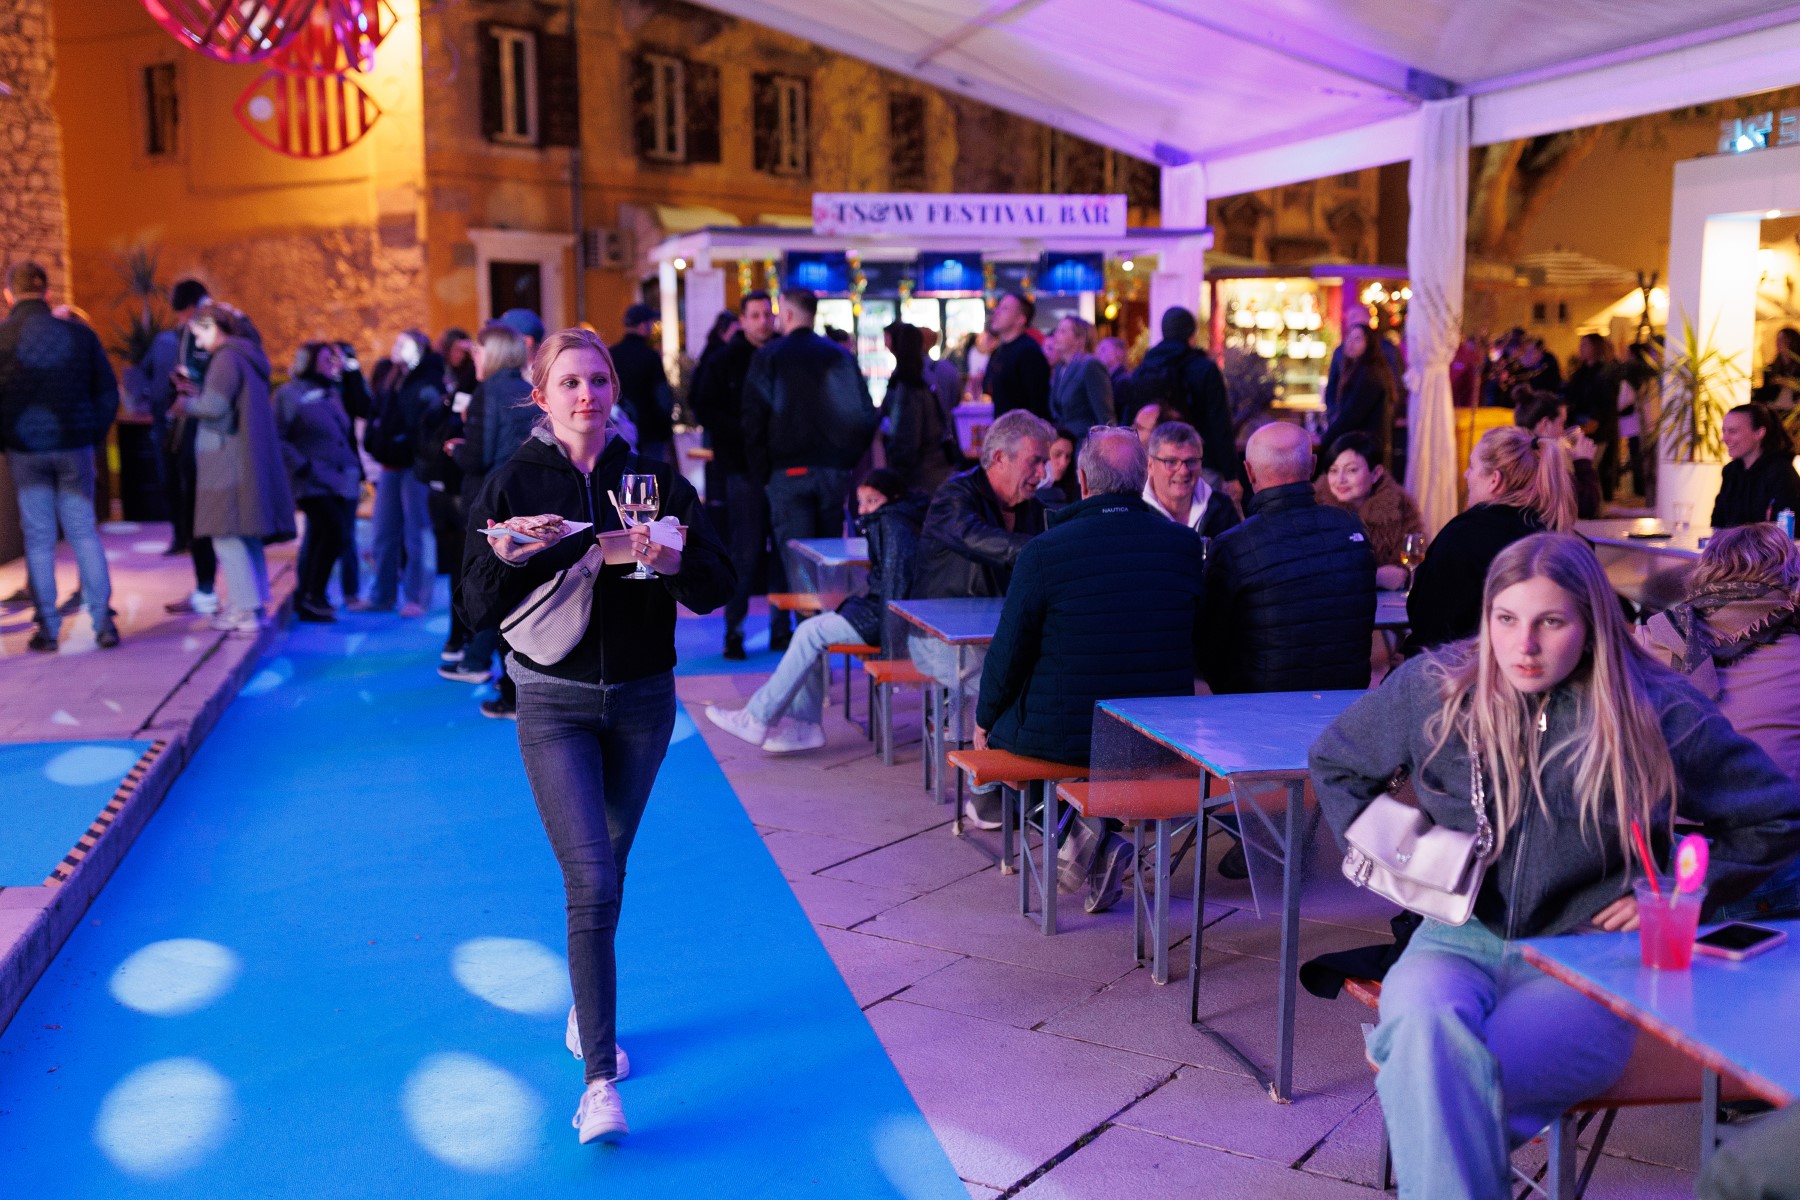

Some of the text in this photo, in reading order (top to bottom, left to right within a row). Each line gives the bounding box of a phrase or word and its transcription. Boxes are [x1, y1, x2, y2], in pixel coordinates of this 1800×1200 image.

[835, 203, 1110, 224] TS&W FESTIVAL BAR
